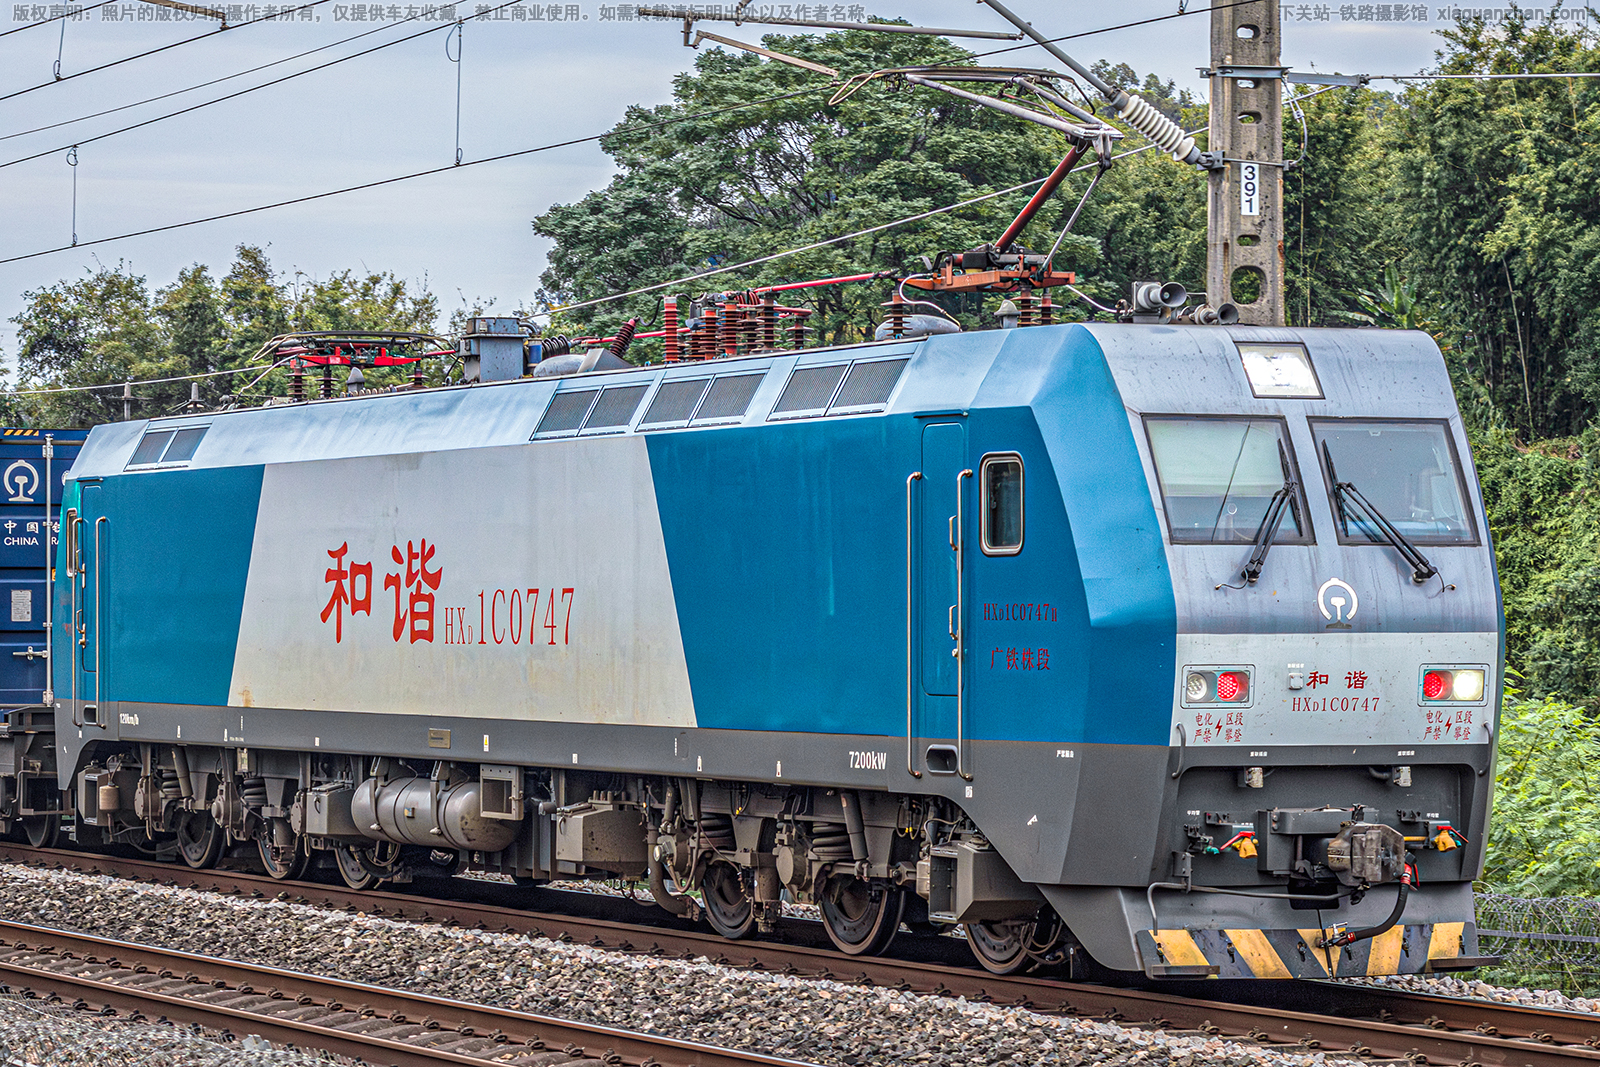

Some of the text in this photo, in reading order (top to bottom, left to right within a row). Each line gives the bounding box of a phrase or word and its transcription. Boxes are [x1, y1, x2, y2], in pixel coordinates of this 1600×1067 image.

[1244, 165, 1256, 213] 391
[4, 536, 39, 546] CHINA
[320, 538, 443, 644] 和谐
[990, 647, 1050, 671] 广铁株段
[1306, 670, 1368, 689] 和谐
[1292, 697, 1380, 712] HXD1C0747
[849, 751, 887, 770] 7200kW
